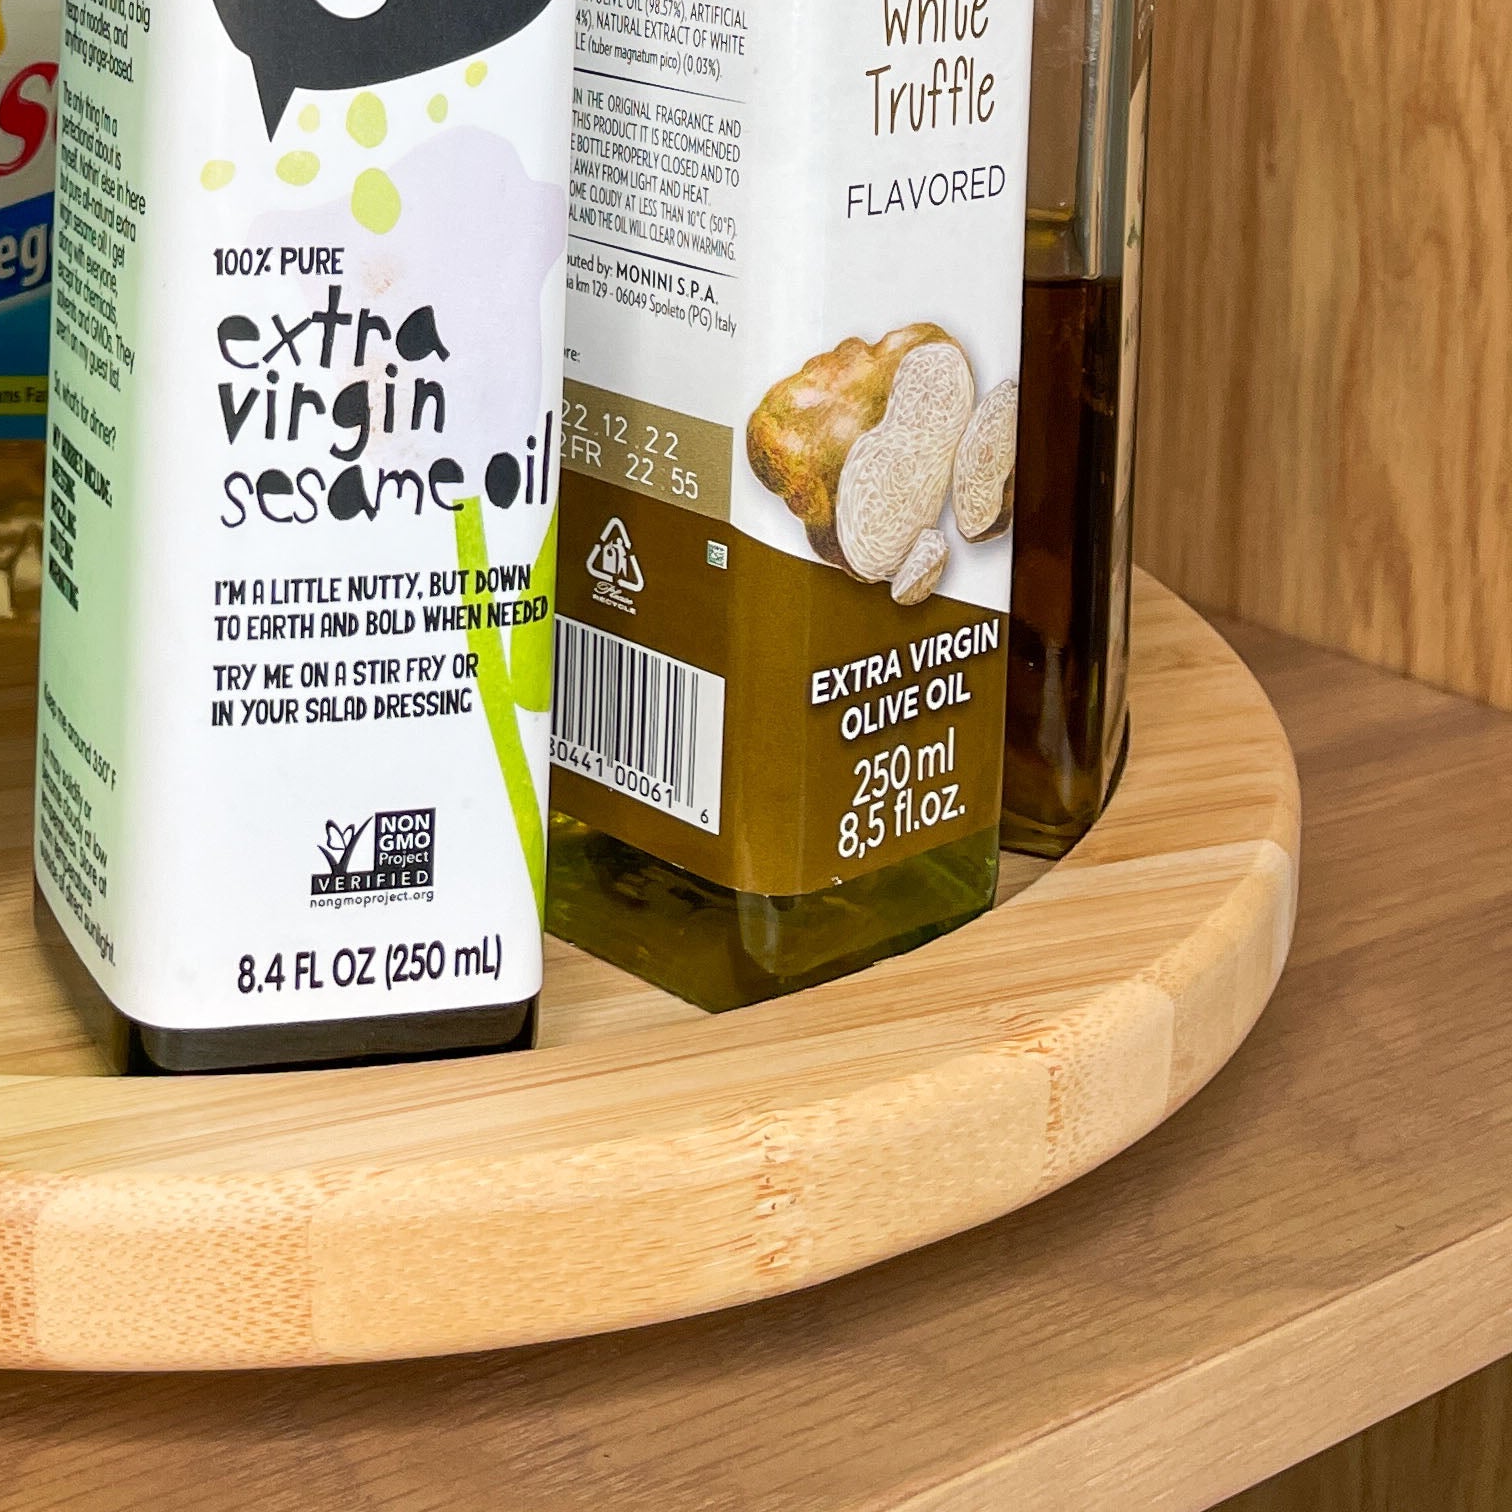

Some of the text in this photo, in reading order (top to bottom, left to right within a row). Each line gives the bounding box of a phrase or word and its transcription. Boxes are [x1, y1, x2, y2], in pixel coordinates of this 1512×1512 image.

[596, 12, 746, 56] NATURAL EXTRACT OF WHITE
[865, 55, 996, 137] Truffle
[847, 165, 1007, 220] FLAVORED
[213, 246, 345, 277] 100% PURE
[616, 261, 673, 293] MONINI
[676, 276, 719, 306] S.P.A.
[216, 284, 451, 370] extra
[615, 288, 738, 338] 06049 Spoleto (PG) Italy
[217, 362, 447, 463] virgin
[220, 410, 553, 528] sesame oil
[251, 578, 265, 605] A
[270, 576, 342, 605] LITTLE
[348, 572, 424, 602] NUTTY,
[429, 569, 470, 596] BUT
[475, 564, 531, 593] DOWN
[214, 595, 549, 641] TO EARTH AND BOLD WHEN NEEDED
[213, 652, 480, 691] TRY ME ON A STIR FRY OR
[811, 618, 1000, 705] EXTRA VIRGIN
[212, 688, 473, 727] IN YOUR SALAD DRESSING
[841, 672, 972, 741] OLIVE OIL
[852, 726, 955, 808] 250 ml
[613, 764, 710, 825] 00061 6
[379, 831, 431, 852] GMO
[380, 813, 431, 834] NON
[838, 783, 966, 859] 8,5 fl.oz.
[317, 870, 429, 892] VERIFIED
[379, 849, 429, 869] Project
[309, 888, 435, 909] nongmoproject.org
[238, 933, 502, 994] 8.4 FL OZ (250 mL)
